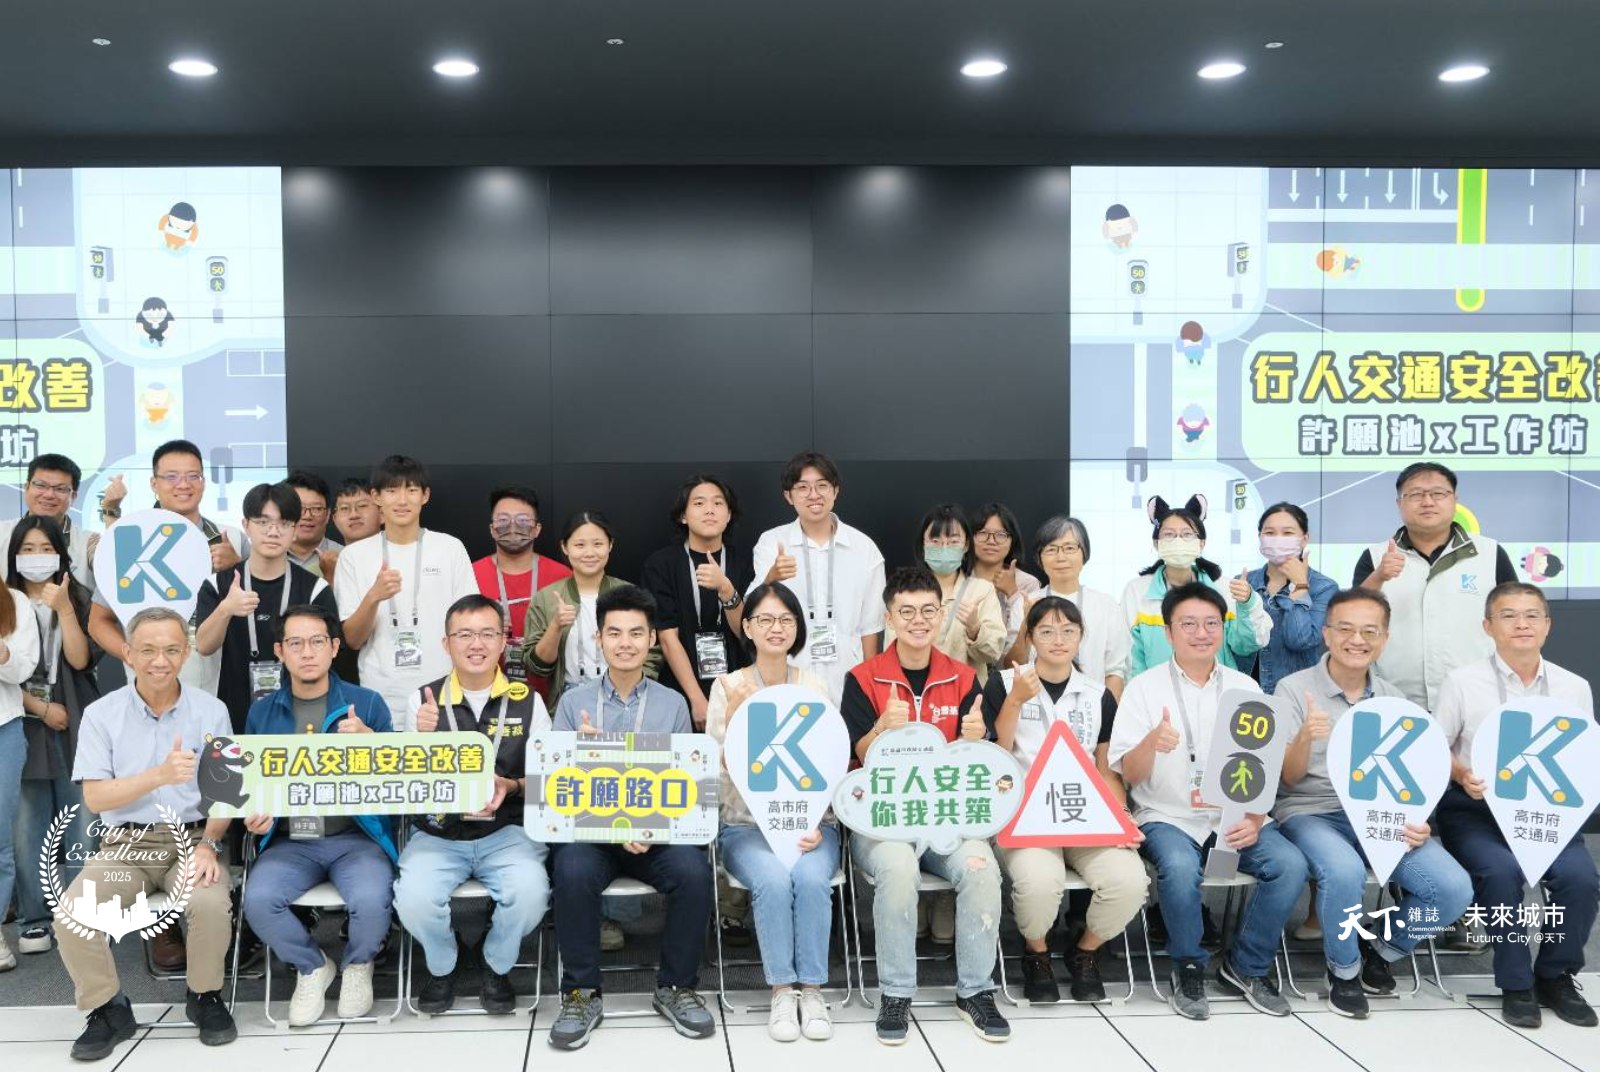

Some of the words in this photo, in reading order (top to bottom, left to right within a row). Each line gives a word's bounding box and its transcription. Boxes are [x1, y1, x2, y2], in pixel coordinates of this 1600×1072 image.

[1250, 351, 1600, 403] 行人交通安全改
[1236, 711, 1270, 740] 50
[260, 744, 485, 776] 行人交通安全改善
[748, 702, 828, 792] K
[1348, 711, 1430, 806] K
[1494, 710, 1588, 809] K
[556, 776, 688, 808] 許願路口
[869, 763, 992, 795] 行人安全
[768, 800, 809, 814] 高市府
[870, 796, 992, 828] 你我共築
[1045, 782, 1088, 824] 慢
[1366, 809, 1407, 826] 高市府
[1514, 809, 1561, 827] 高市府
[768, 817, 809, 831] 交通局
[1365, 826, 1405, 843] 交通局
[1513, 826, 1560, 844] 交通局
